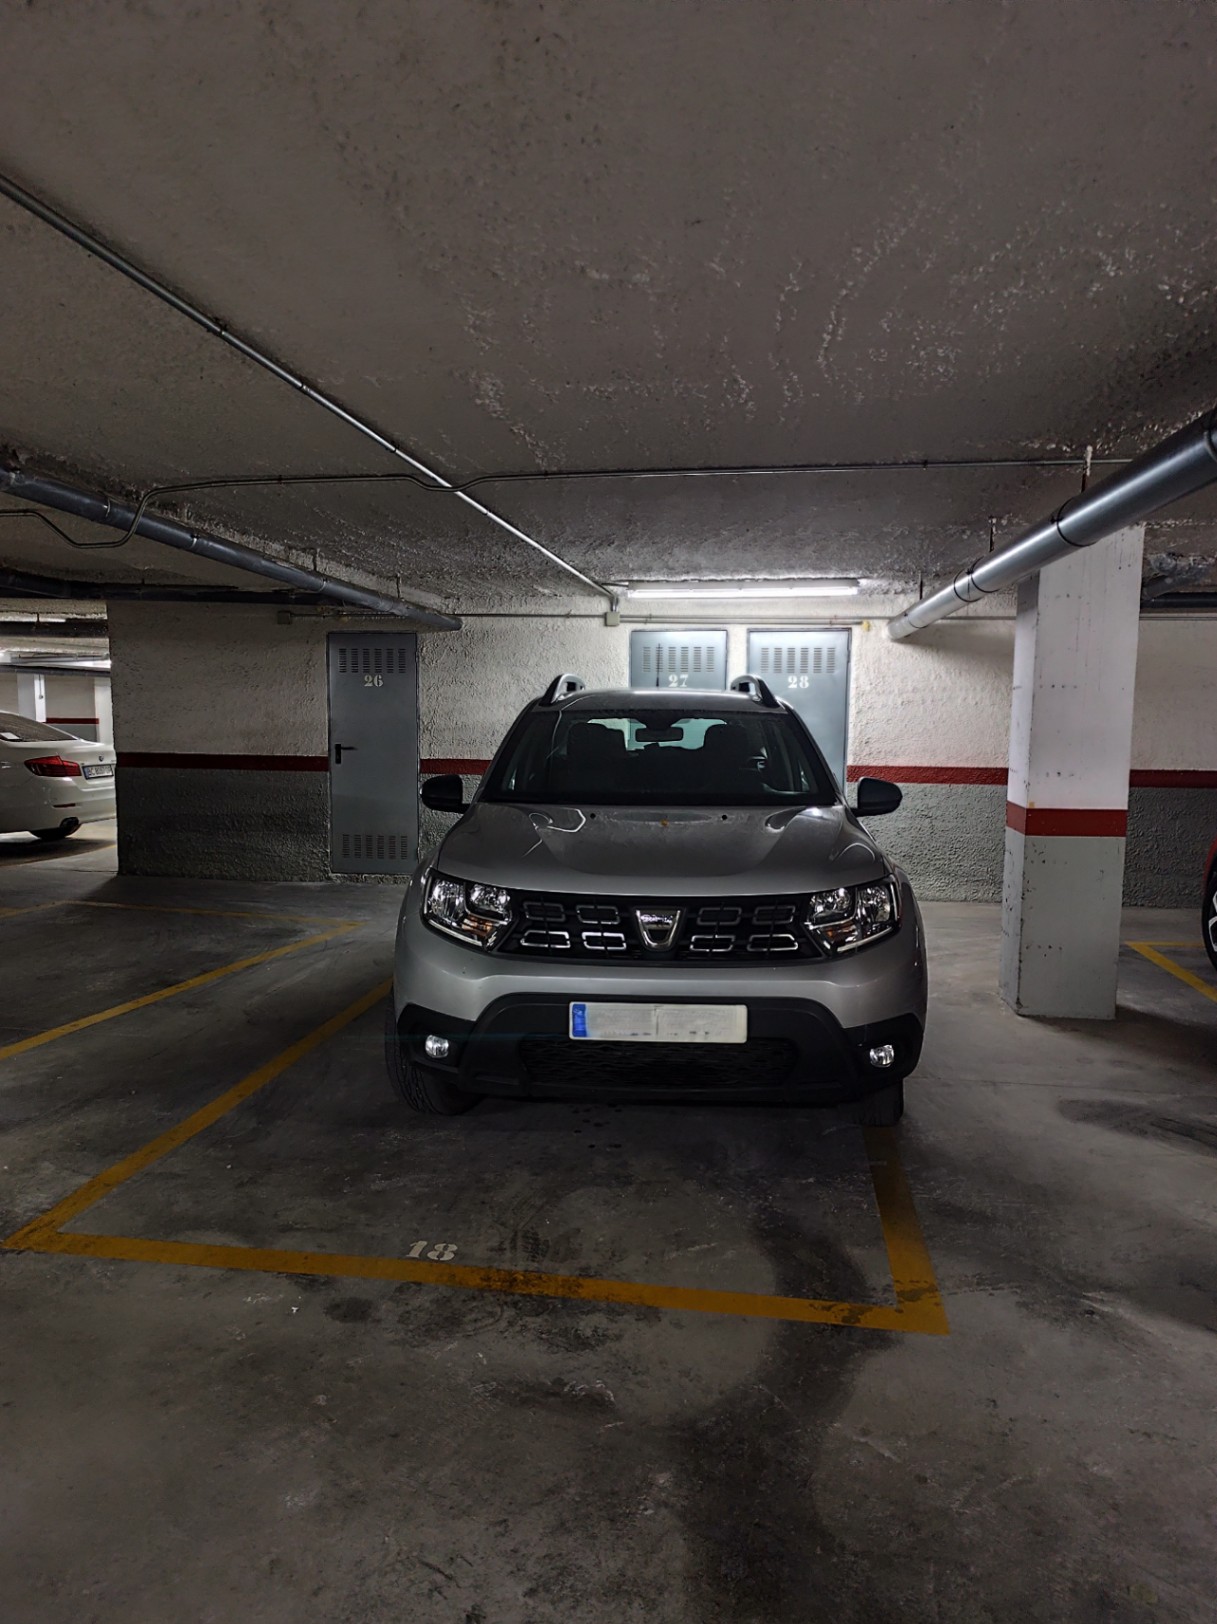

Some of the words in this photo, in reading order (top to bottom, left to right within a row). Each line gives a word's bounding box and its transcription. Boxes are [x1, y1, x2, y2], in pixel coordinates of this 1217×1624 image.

[364, 675, 383, 687] 26
[669, 674, 688, 687] 27
[788, 675, 810, 688] 28
[406, 1240, 457, 1260] 18
